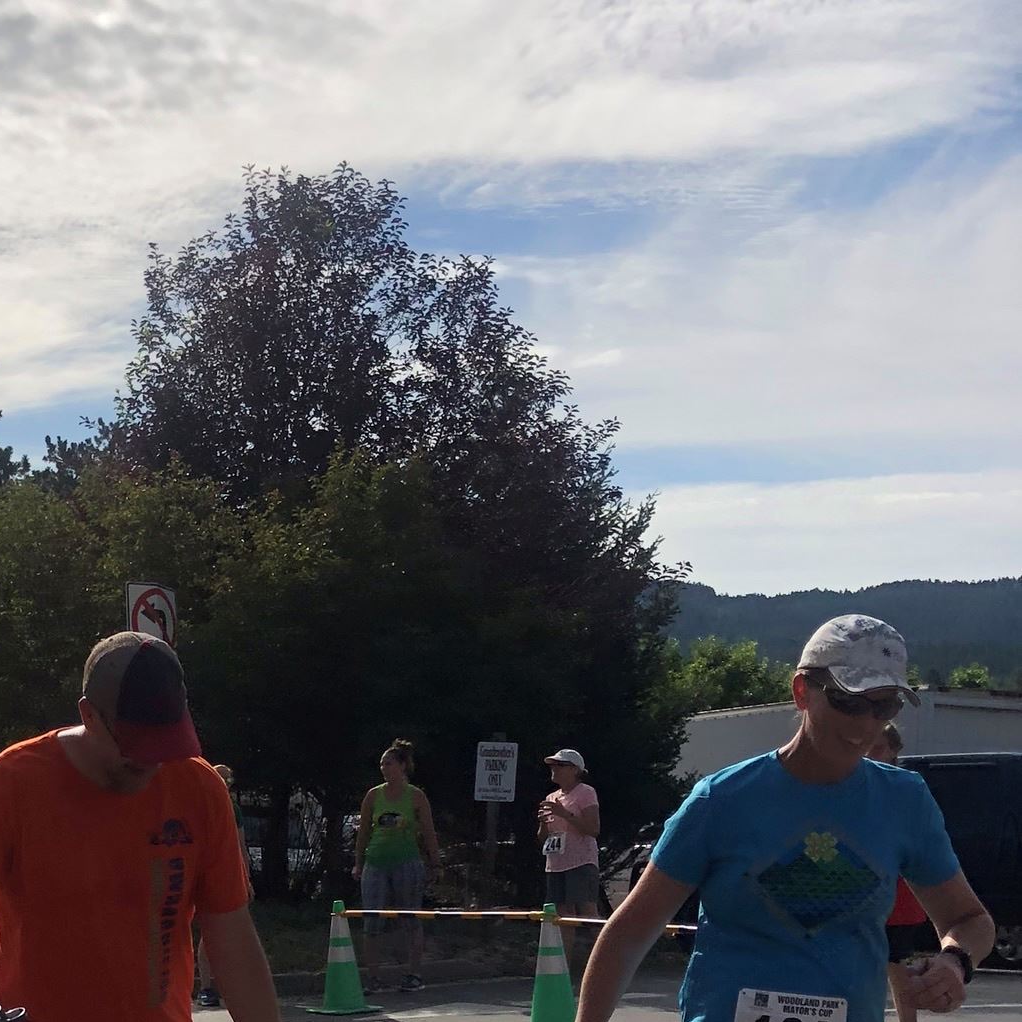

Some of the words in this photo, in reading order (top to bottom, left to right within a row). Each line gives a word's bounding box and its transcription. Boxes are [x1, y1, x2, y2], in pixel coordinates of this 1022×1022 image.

[545, 838, 561, 851] 244
[778, 995, 819, 1008] WOODLAND
[822, 999, 840, 1009] PARK
[783, 1005, 816, 1016] MAYOR'S
[819, 1008, 833, 1017] CUP
